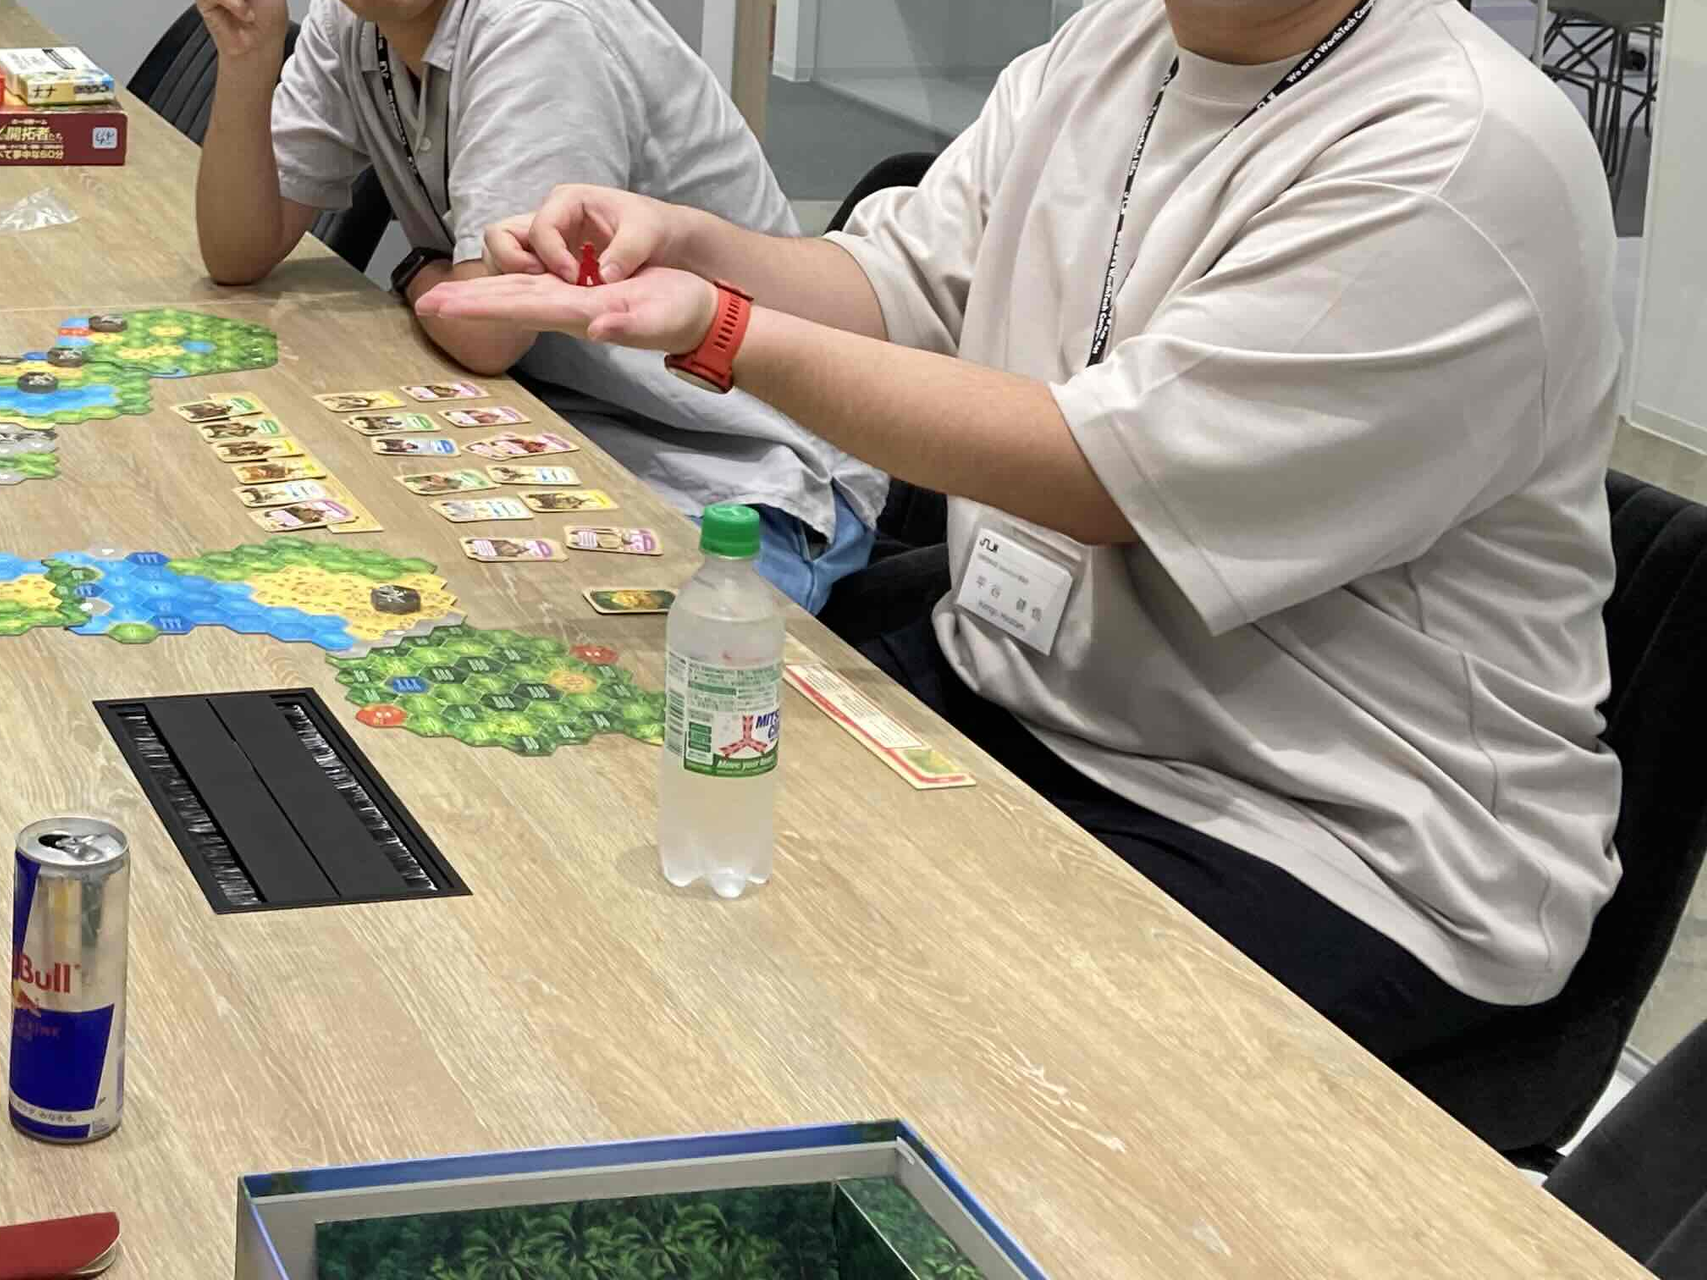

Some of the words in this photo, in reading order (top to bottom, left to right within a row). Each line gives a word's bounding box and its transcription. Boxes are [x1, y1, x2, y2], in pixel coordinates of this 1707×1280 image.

[1286, 70, 1302, 83] We
[1301, 58, 1315, 71] are
[1317, 18, 1357, 53] WorthTech
[19, 953, 71, 994] Bull
